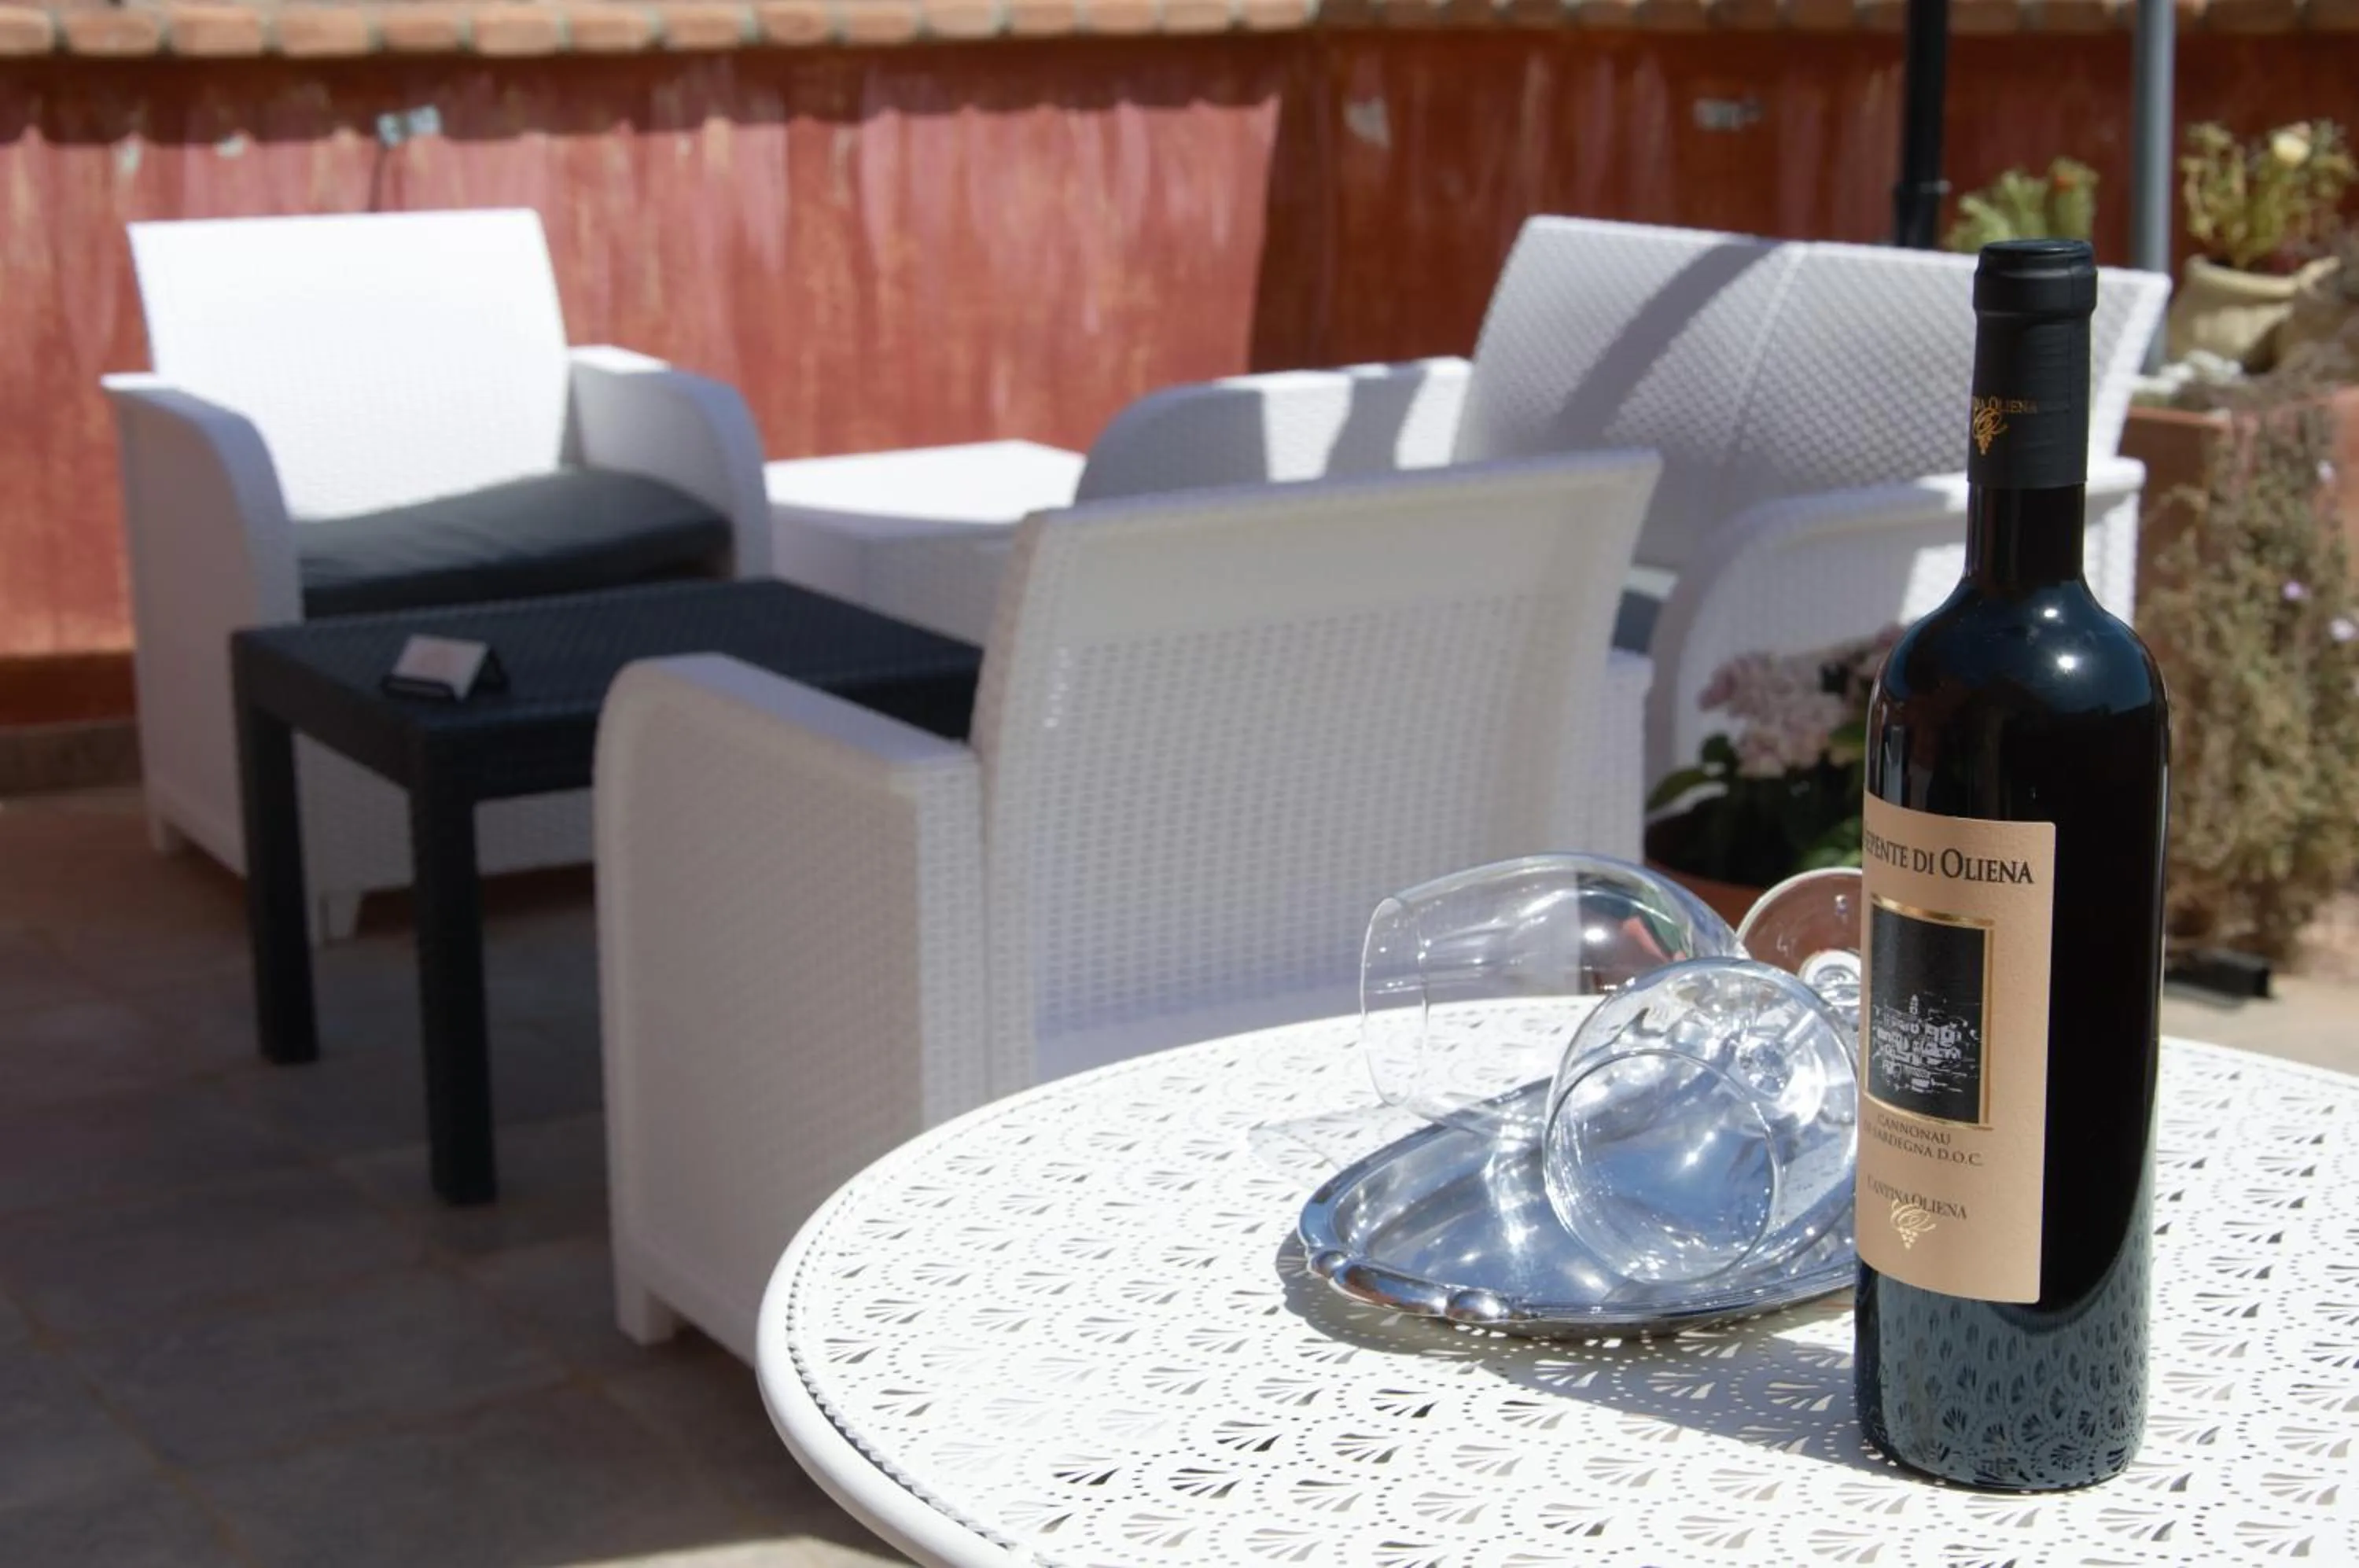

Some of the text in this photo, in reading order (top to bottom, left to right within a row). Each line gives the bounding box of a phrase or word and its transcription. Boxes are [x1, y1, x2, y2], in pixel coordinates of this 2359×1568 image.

[1912, 848, 1935, 875] DI
[1941, 848, 2034, 884] OLIENA
[1878, 1113, 1951, 1145] CANNONAU
